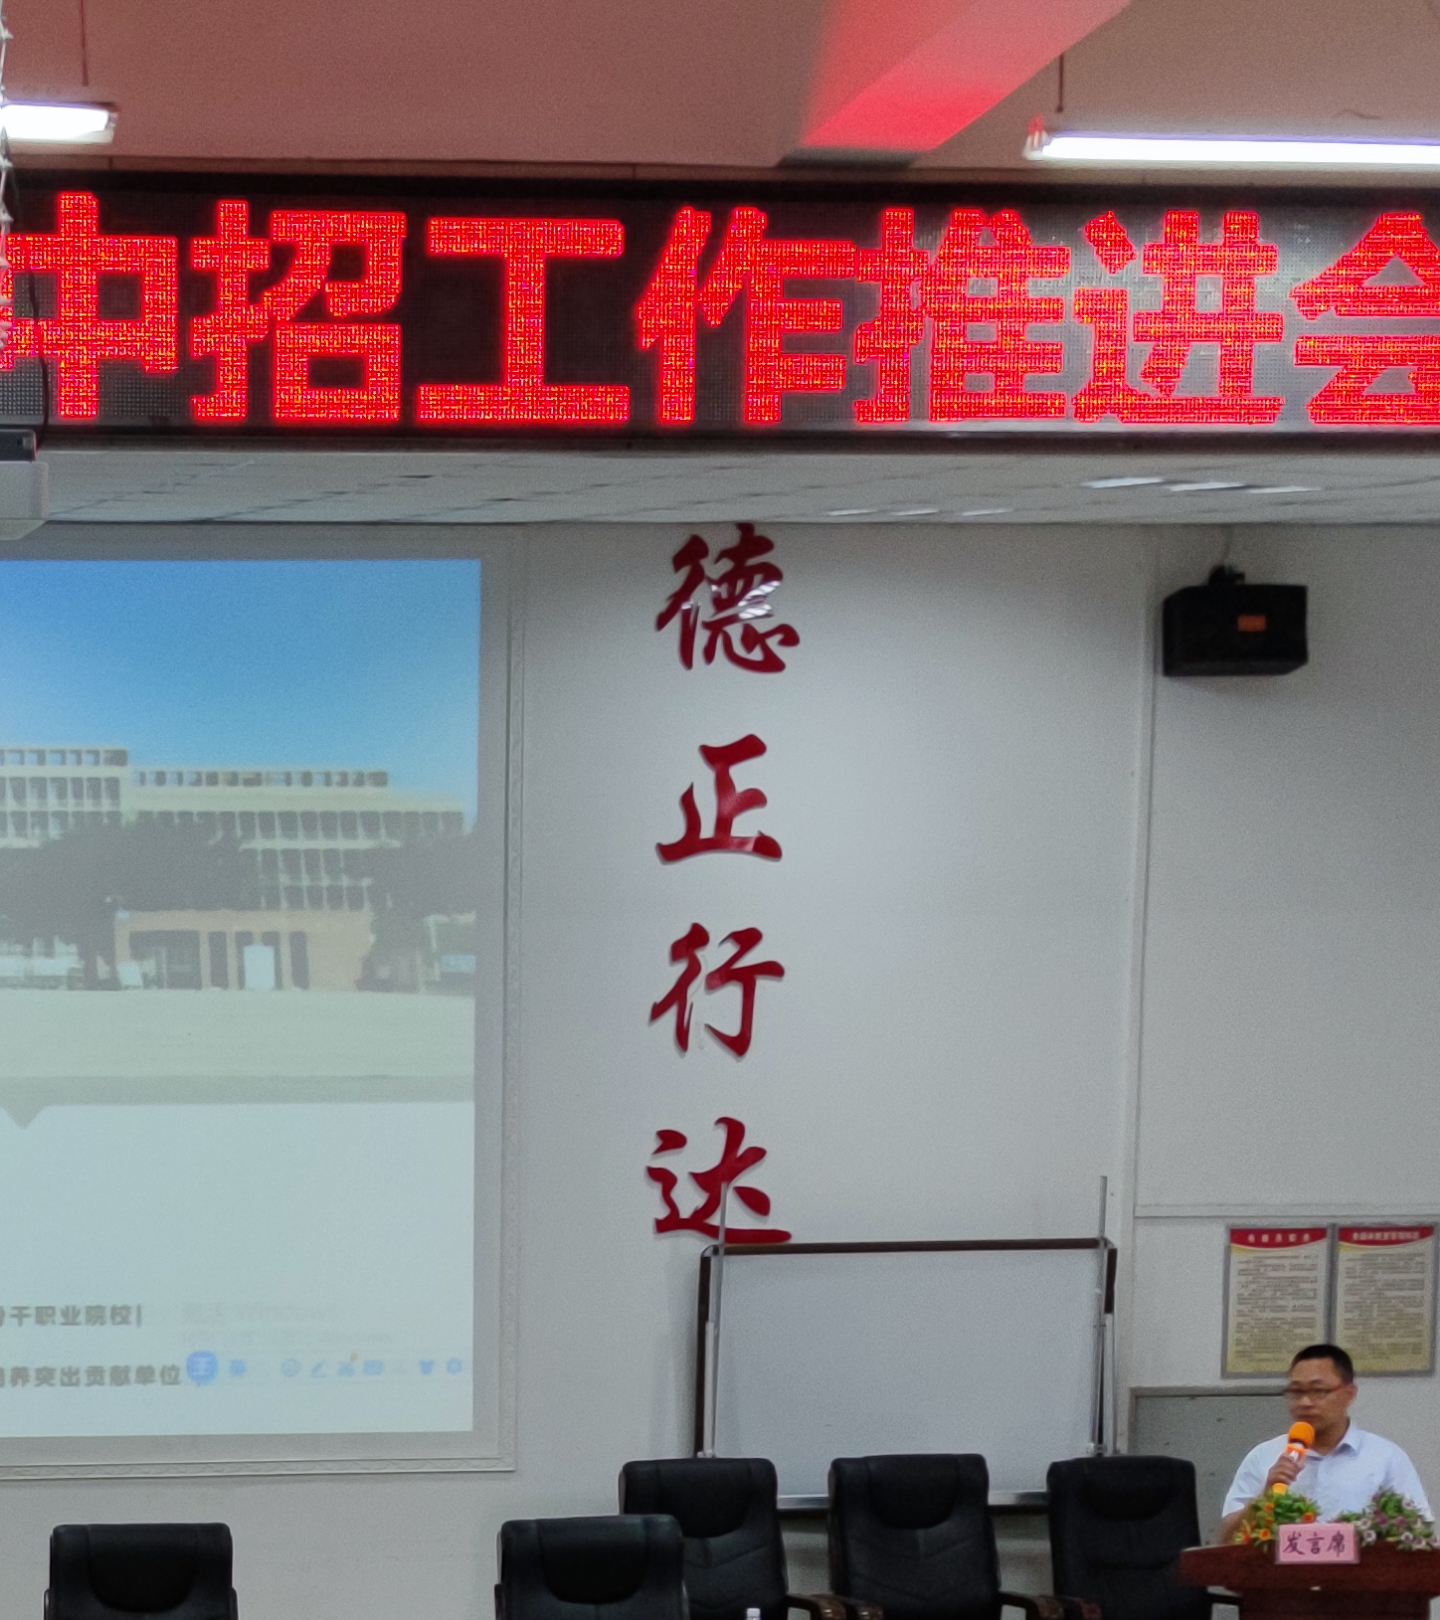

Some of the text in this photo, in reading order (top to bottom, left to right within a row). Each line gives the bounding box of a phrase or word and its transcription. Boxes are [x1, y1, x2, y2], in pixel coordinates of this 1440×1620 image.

[646, 523, 801, 1245] 德正行达
[1282, 1530, 1346, 1558] 发言席
